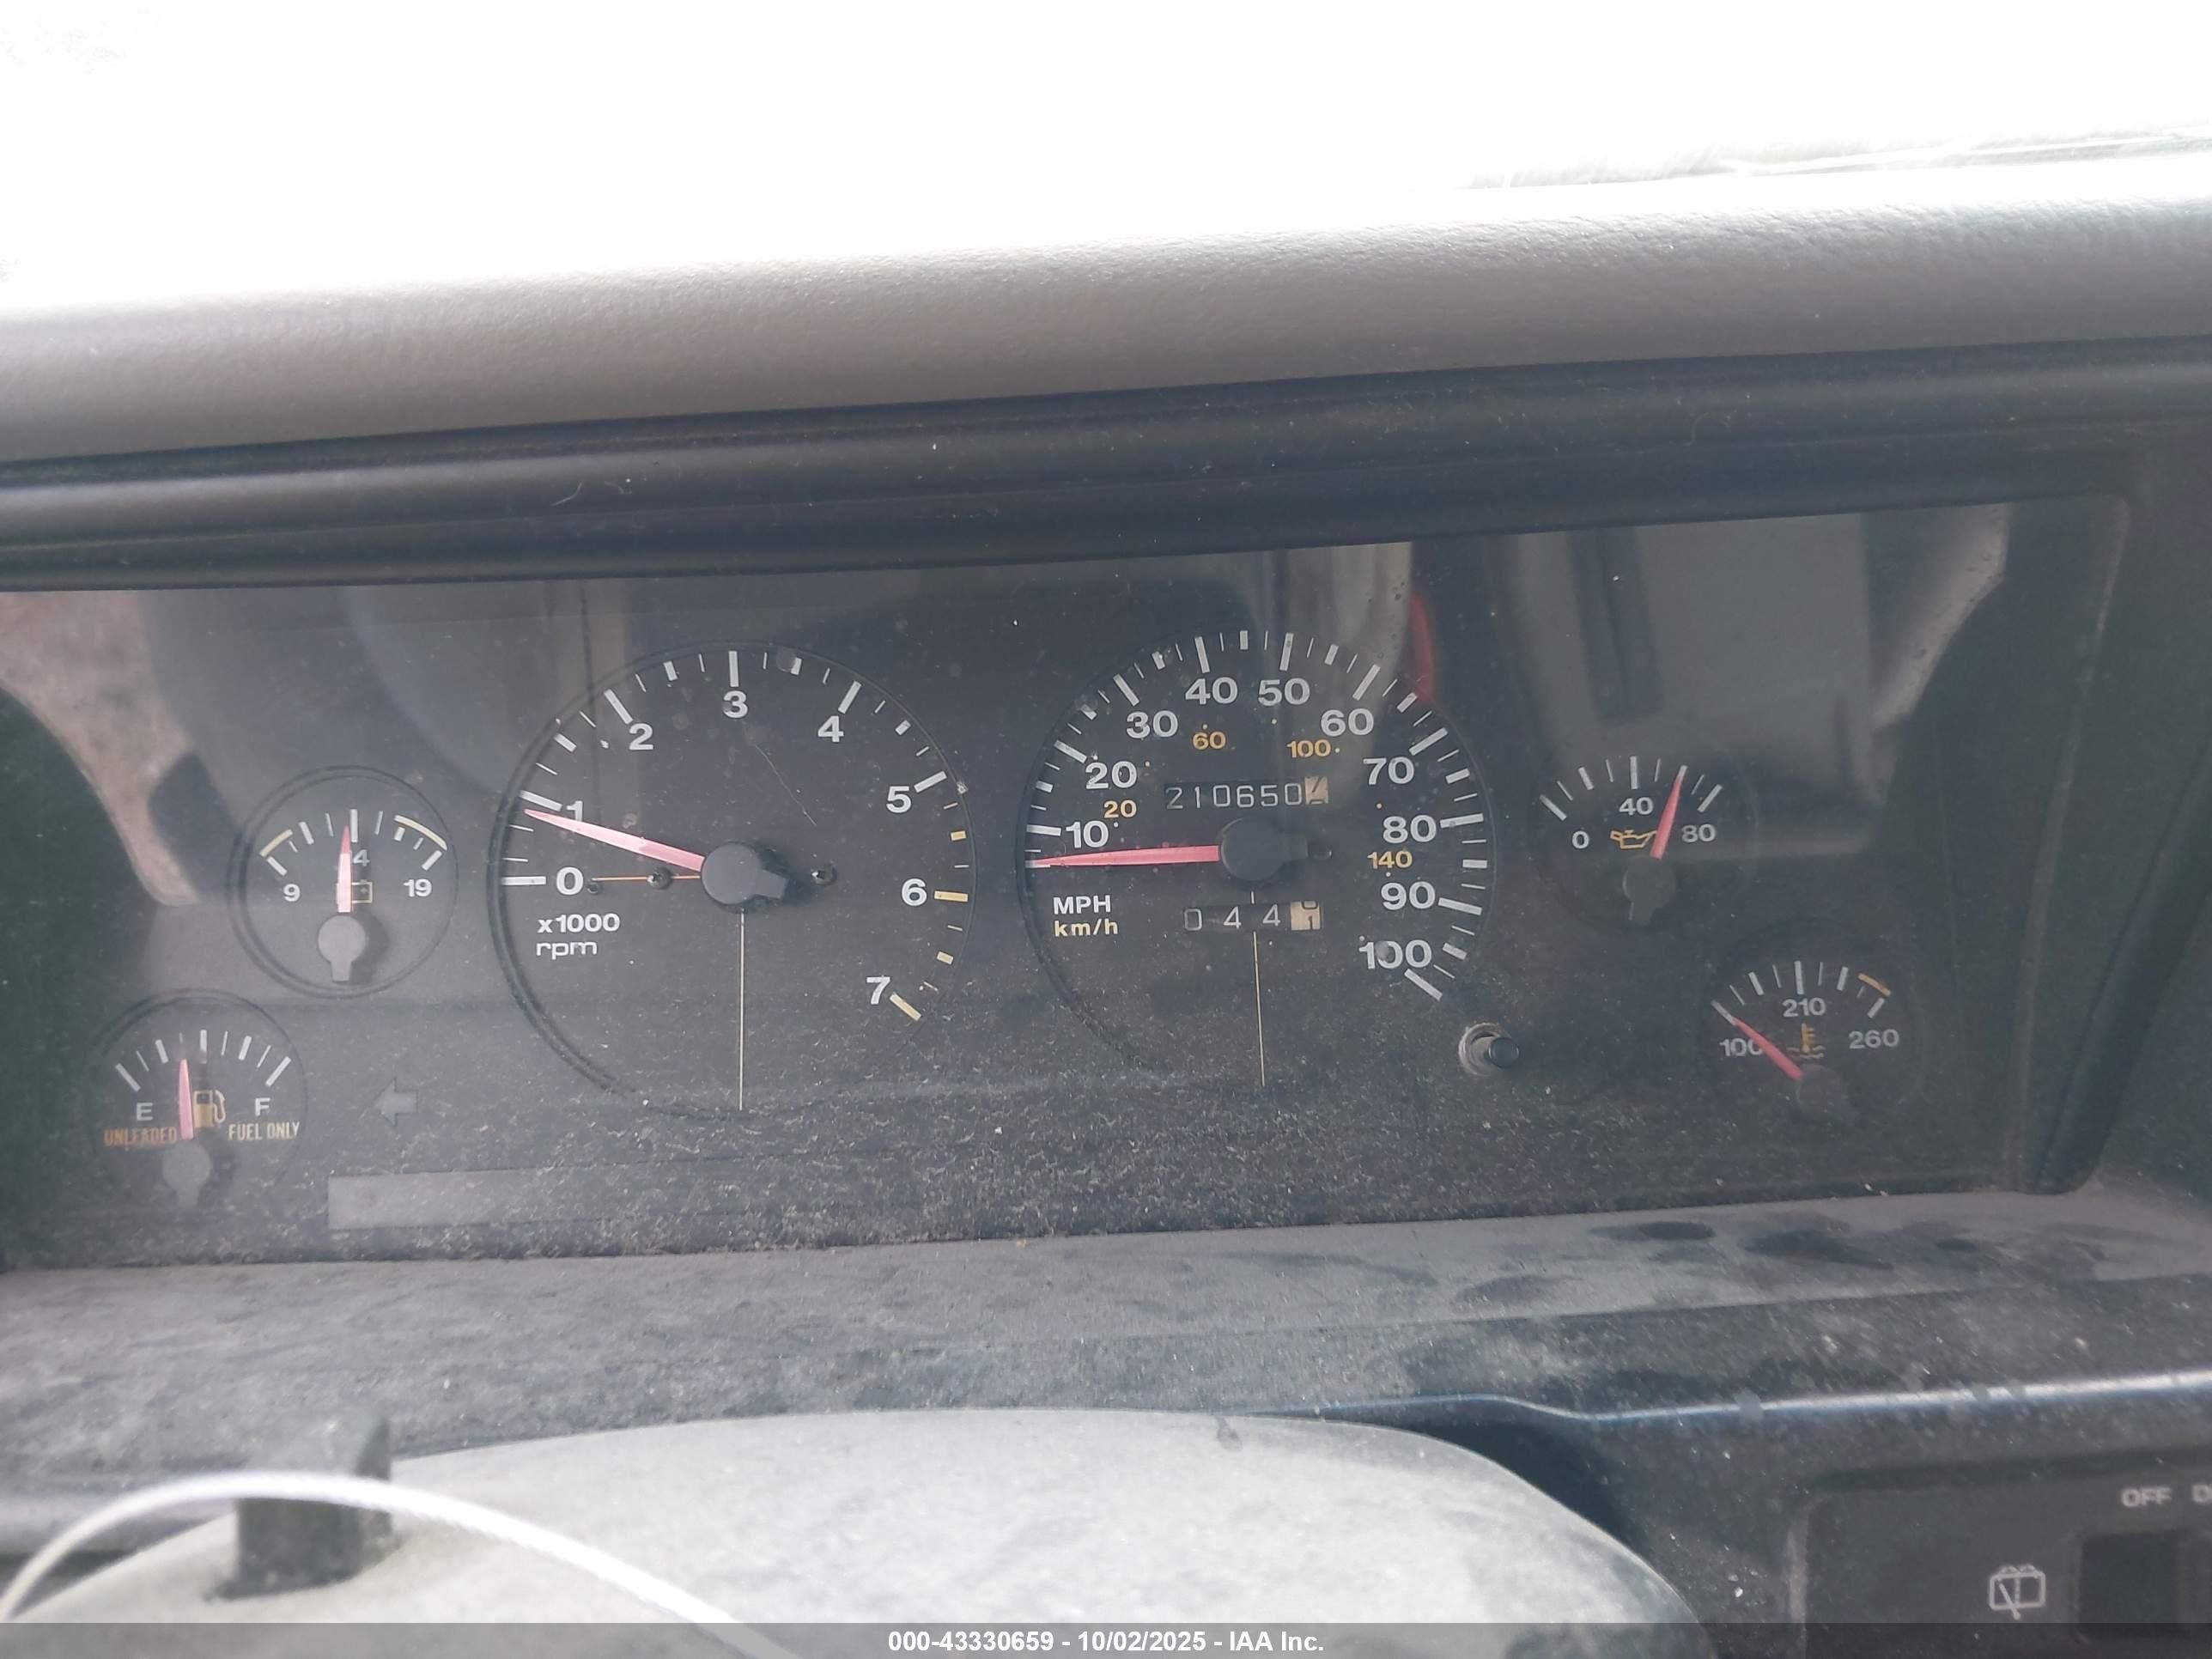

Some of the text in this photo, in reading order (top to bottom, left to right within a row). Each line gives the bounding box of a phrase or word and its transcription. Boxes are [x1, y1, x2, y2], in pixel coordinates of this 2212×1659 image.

[1185, 677, 1238, 704] 40
[1258, 678, 1310, 706] 50
[722, 690, 748, 719] 3
[817, 716, 844, 743] 4
[1126, 710, 1178, 738] 30
[1321, 708, 1374, 736] 60
[629, 723, 653, 750] 2
[1193, 732, 1226, 750] 60
[1287, 738, 1331, 758] 100
[1085, 760, 1137, 789] 20
[1363, 757, 1414, 785] 70
[885, 785, 911, 813] 5
[1103, 799, 1137, 818] 20
[1619, 797, 1654, 815] 40
[567, 800, 584, 821] 1
[1066, 821, 1109, 848] 10
[1382, 814, 1437, 843] 80
[1571, 830, 1589, 848] 0
[1681, 823, 1716, 842] 80
[1368, 850, 1413, 870] 140
[404, 878, 433, 896] 19
[556, 866, 584, 896] 0
[283, 884, 301, 902] 9
[901, 879, 927, 906] 6
[1381, 883, 1436, 910] 90
[1053, 896, 1111, 915] MPH
[538, 913, 620, 933] x1000
[1054, 919, 1119, 938] km/h
[536, 941, 598, 960] rpm
[1360, 939, 1432, 969] 100
[866, 976, 890, 1005] 7
[1782, 997, 1826, 1018] 210
[1849, 1030, 1899, 1049] 260
[136, 1103, 154, 1121] E
[254, 1097, 271, 1116] F
[103, 1127, 178, 1146] UNLEADED
[228, 1121, 301, 1141] FUEL ONLY
[2121, 1487, 2172, 1508] OFF
